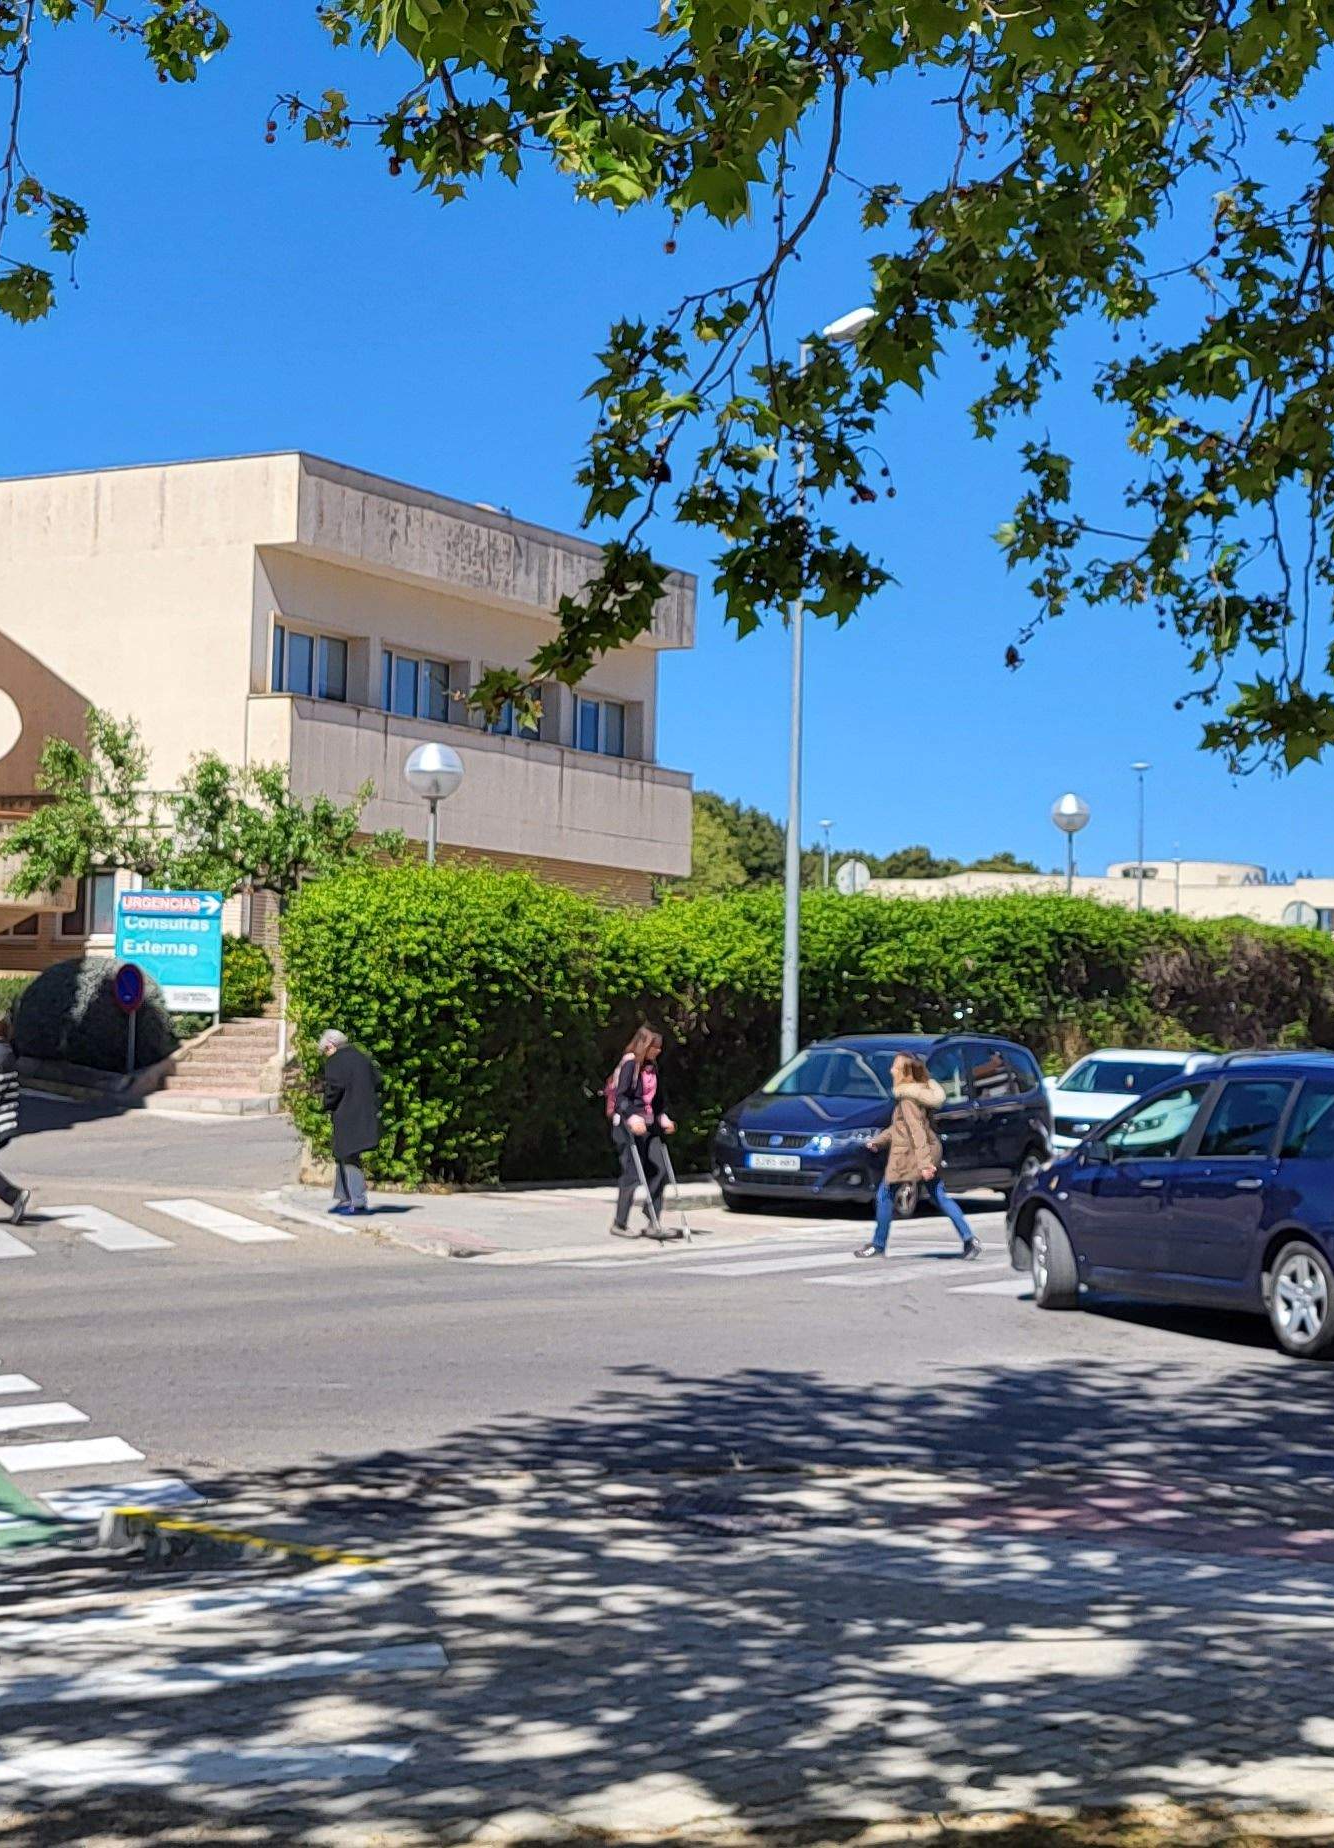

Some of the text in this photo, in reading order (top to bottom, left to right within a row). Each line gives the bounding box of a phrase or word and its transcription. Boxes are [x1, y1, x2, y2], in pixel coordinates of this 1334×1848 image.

[122, 895, 201, 912] URGENCIAS
[124, 915, 210, 932] Consultas
[122, 938, 198, 957] Externas
